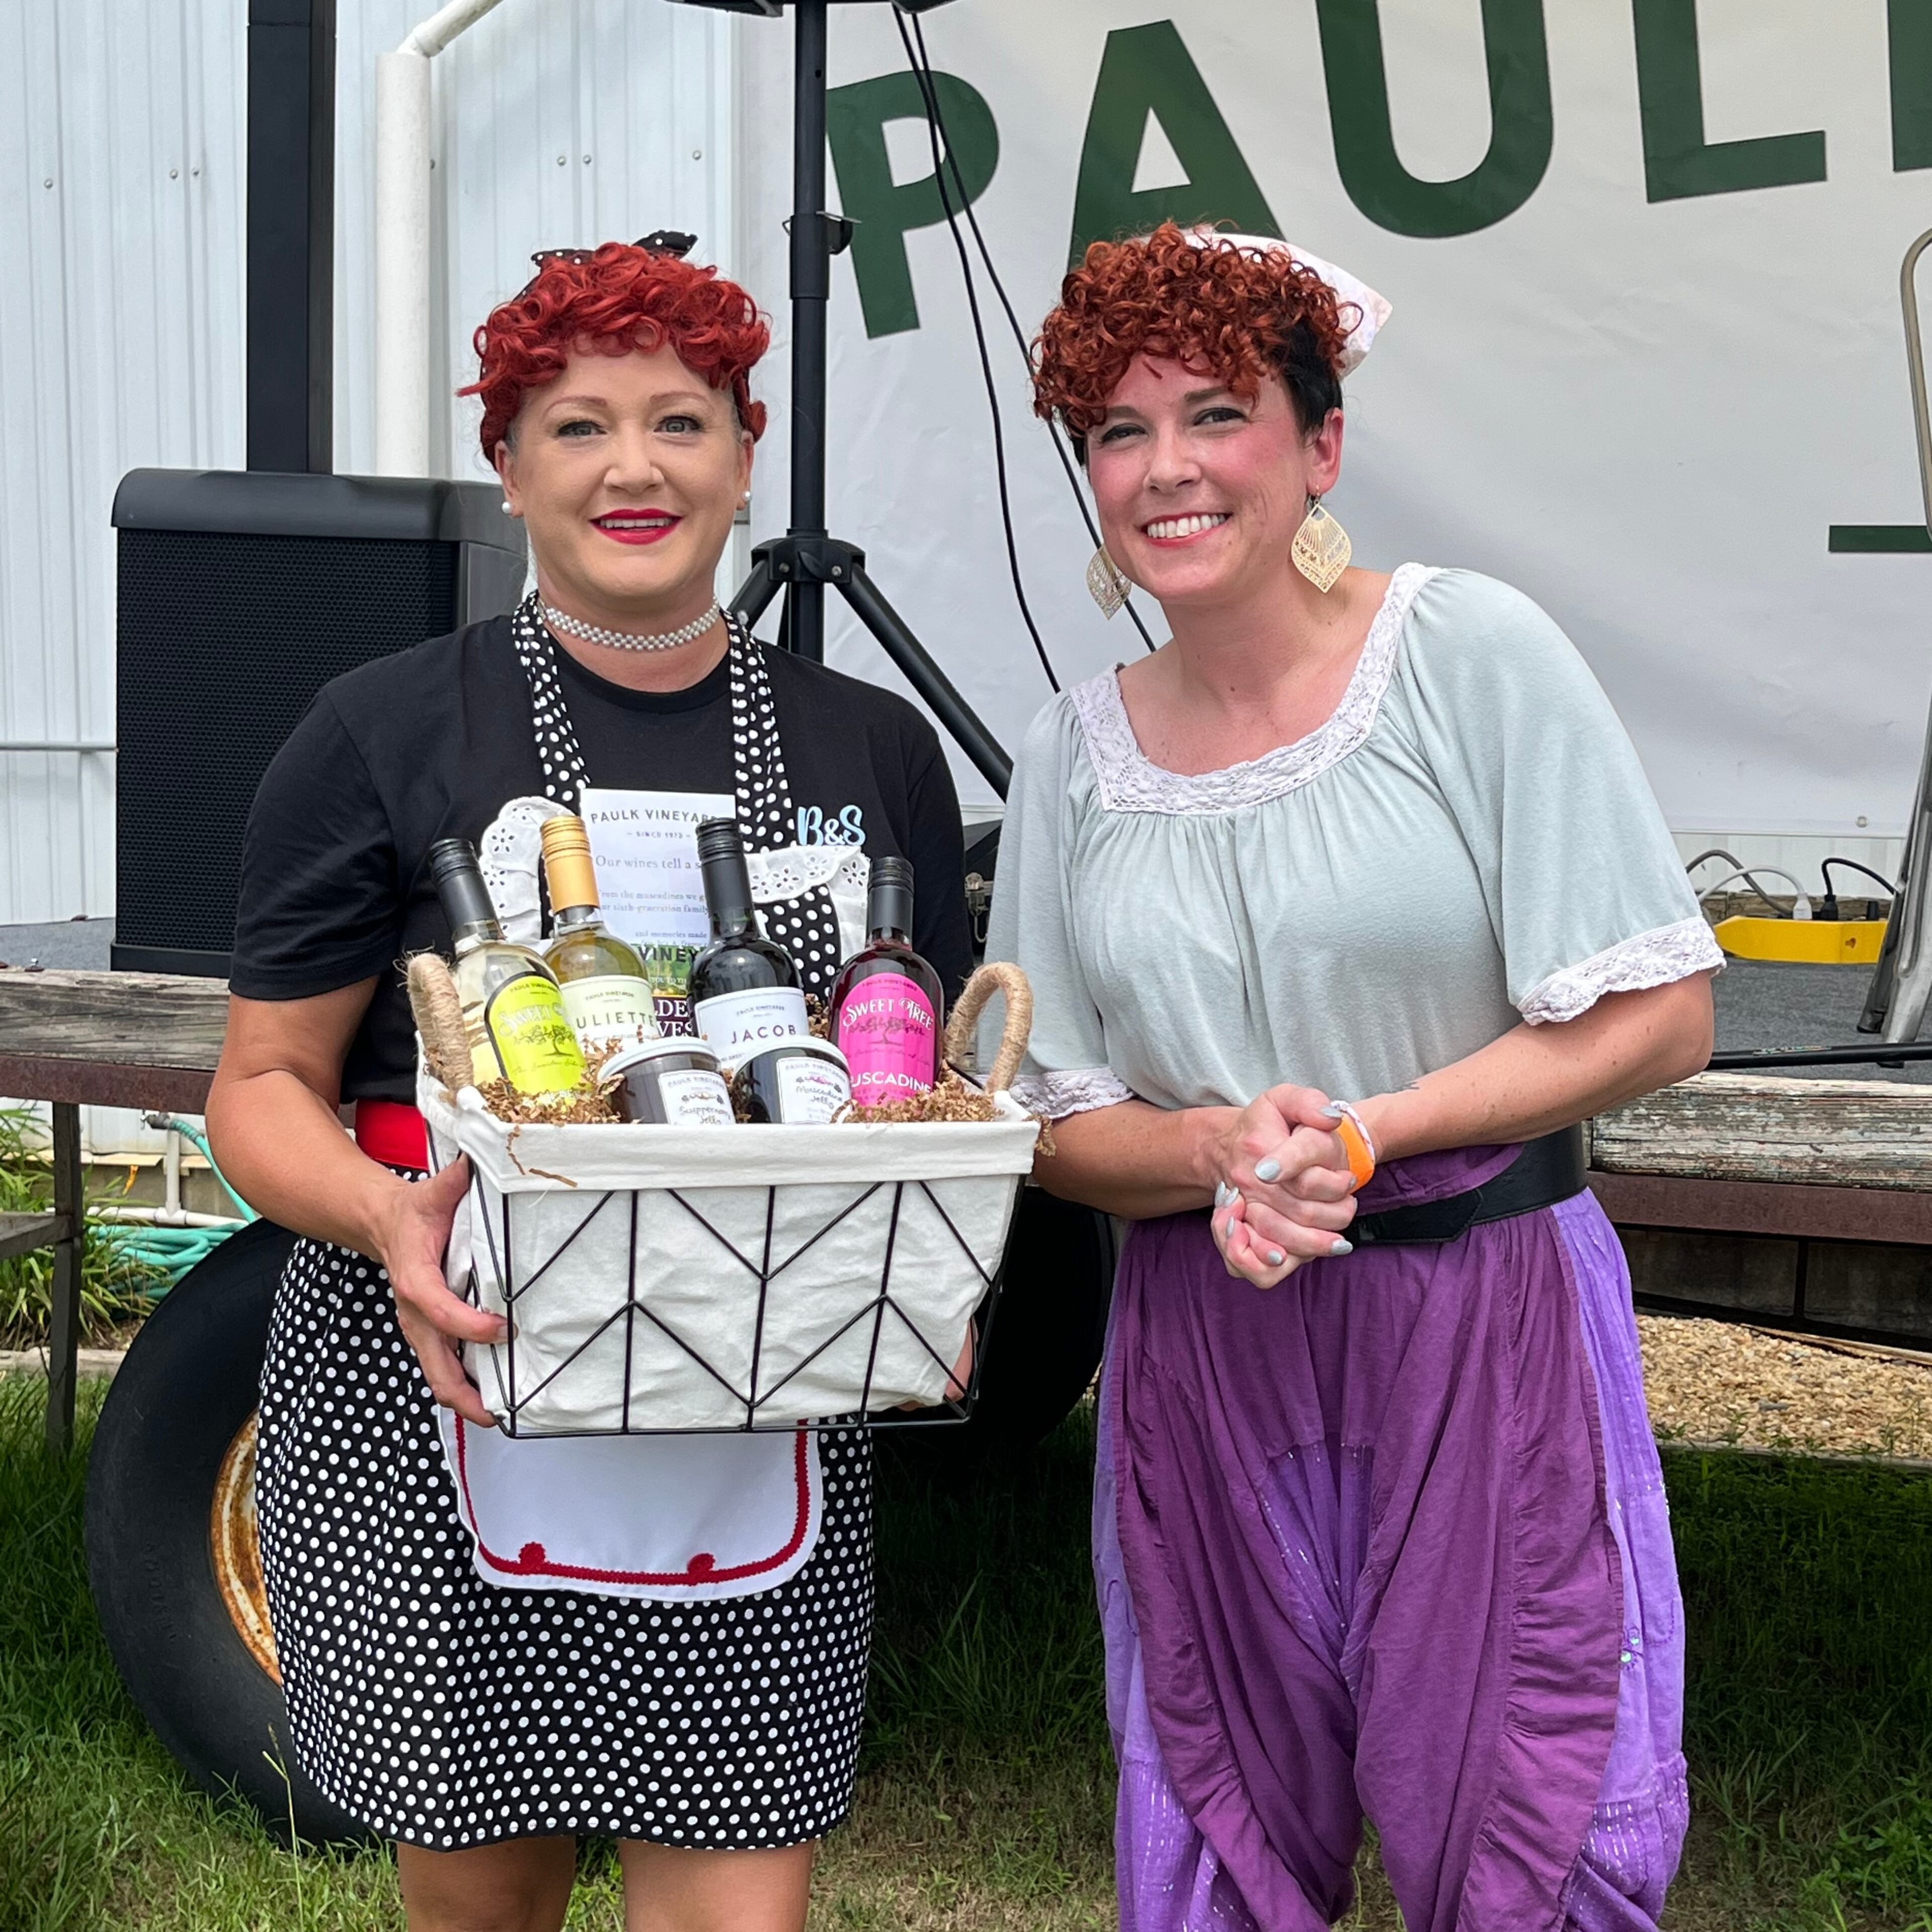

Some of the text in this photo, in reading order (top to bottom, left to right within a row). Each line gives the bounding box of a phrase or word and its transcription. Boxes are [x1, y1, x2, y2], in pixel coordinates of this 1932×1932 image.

[826, 0, 1932, 339] PAUL
[591, 809, 639, 824] PAULK
[798, 804, 866, 846] B&S
[595, 855, 621, 867] Our
[624, 858, 658, 868] wines
[662, 858, 682, 869] tell
[620, 889, 633, 899] the
[638, 945, 703, 963] VINEY
[576, 1011, 655, 1029] ULIETTE
[842, 997, 934, 1031] SWEET TREE
[731, 1024, 796, 1044] JACOB
[851, 1071, 931, 1094] USCADINE
